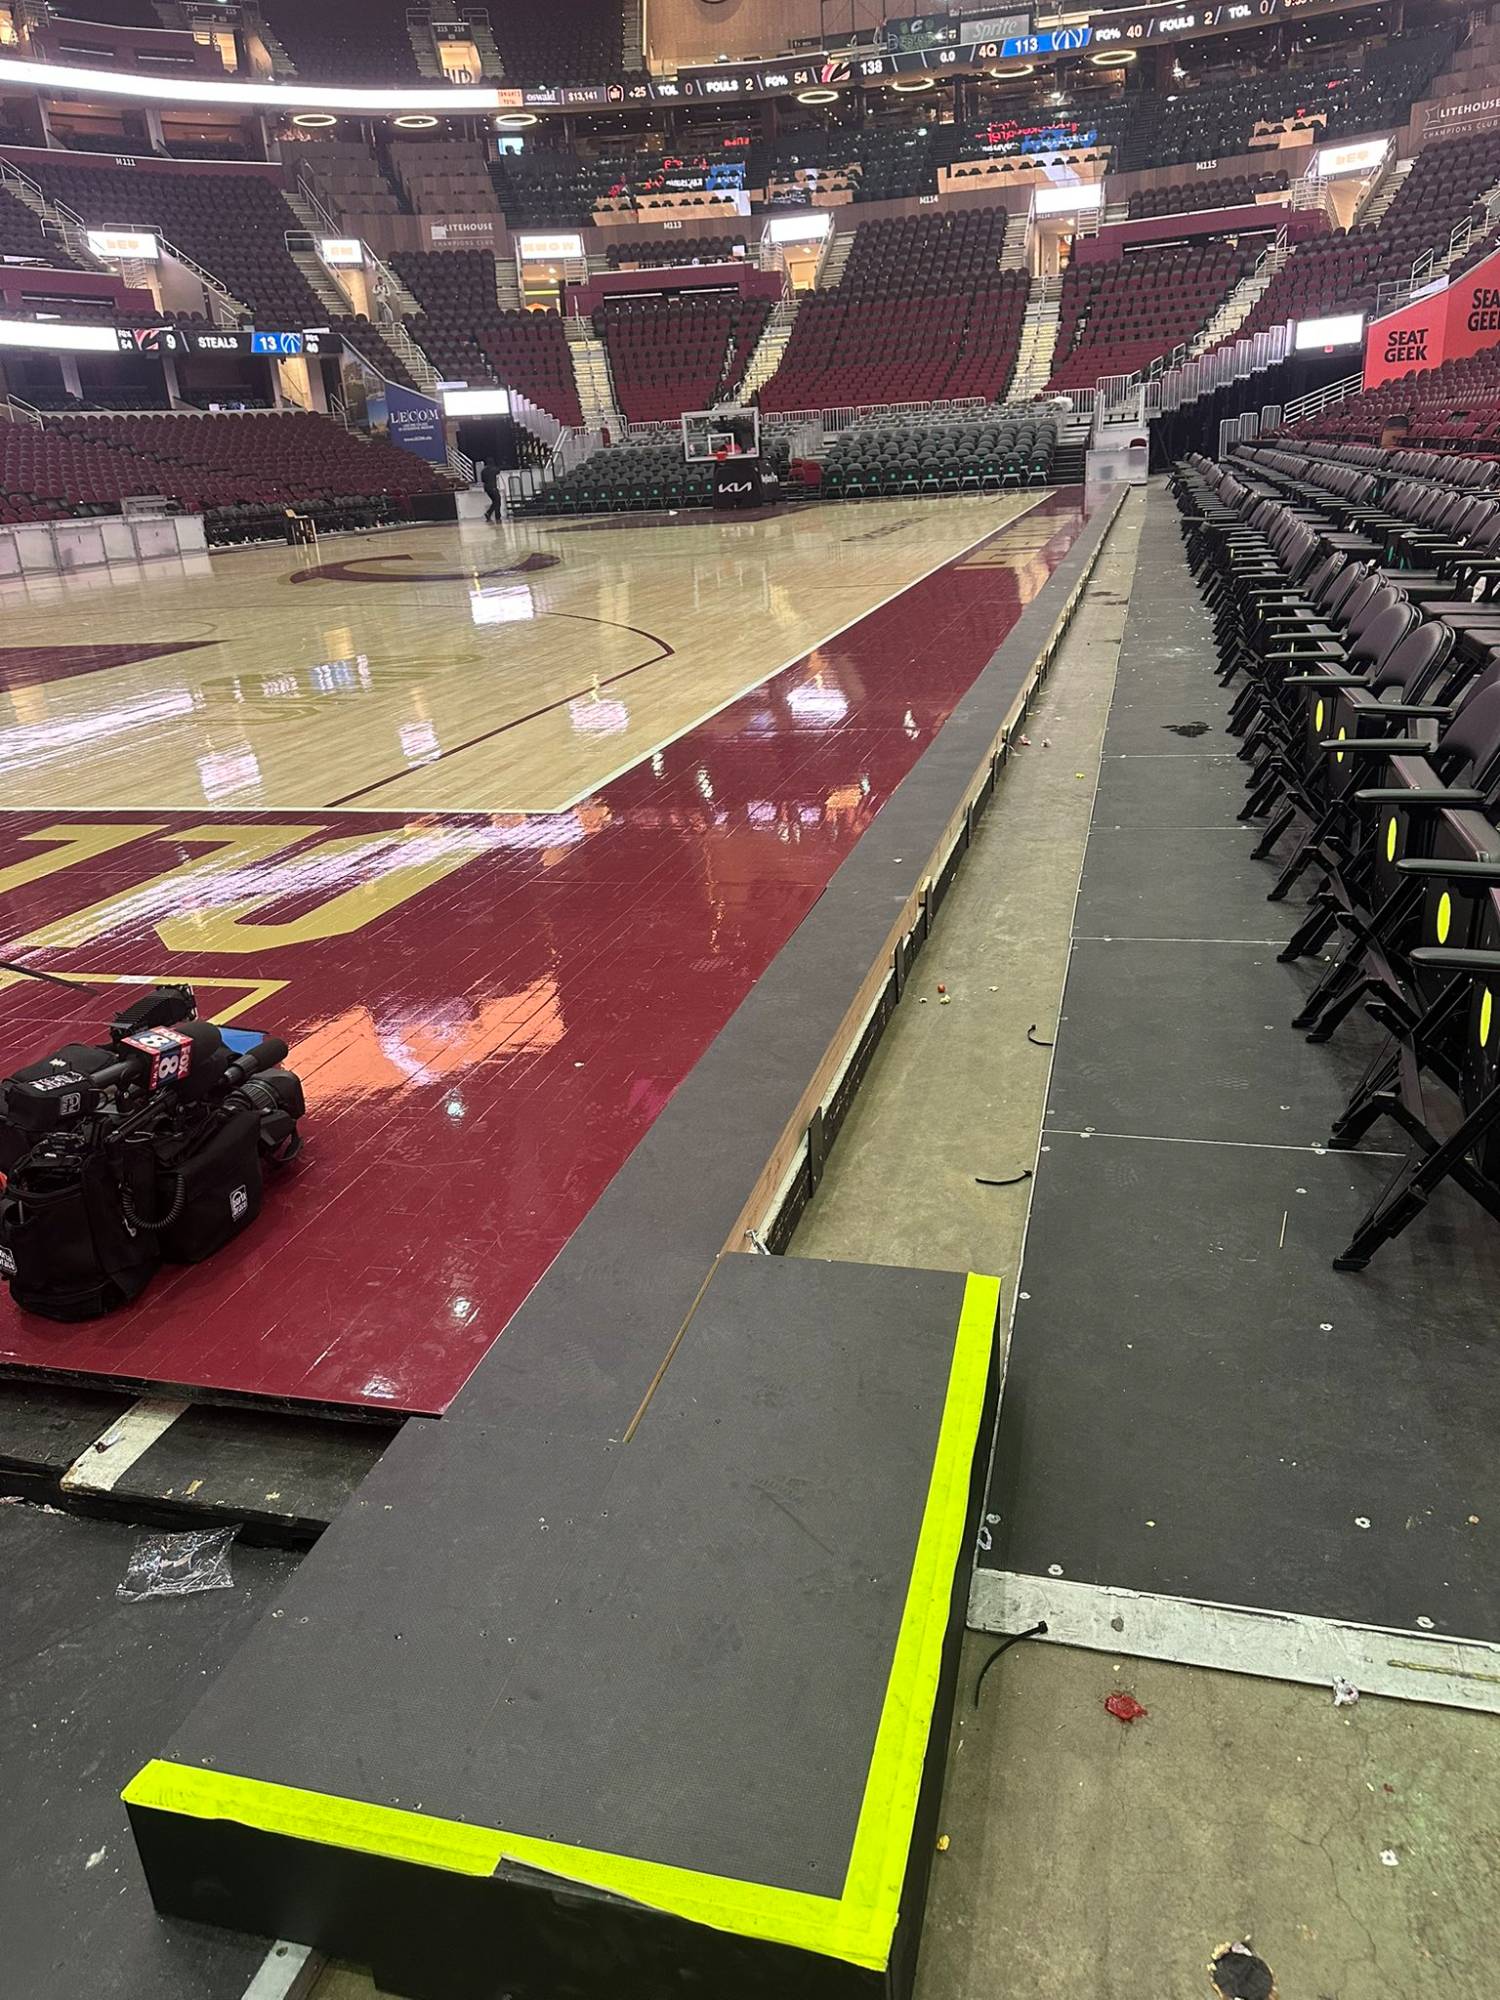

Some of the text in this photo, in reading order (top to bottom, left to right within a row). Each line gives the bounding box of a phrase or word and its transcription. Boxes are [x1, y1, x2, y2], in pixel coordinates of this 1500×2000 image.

[1228, 5, 1252, 19] TOL
[1260, 0, 1269, 14] 0
[973, 18, 1016, 40] Sprite
[1160, 12, 1213, 32] FOULS 2
[1096, 25, 1143, 42] FG% 40
[978, 44, 998, 58] 4Q
[1015, 38, 1039, 53] 113
[860, 61, 883, 75] 138
[706, 79, 753, 93] FOULS 2
[765, 71, 808, 88] FG% 54
[526, 90, 556, 101] oswald
[568, 91, 598, 102] $13,141
[629, 86, 646, 98] +25
[657, 82, 693, 96] TOL 0
[1440, 98, 1500, 118] LITEHOUSE
[1423, 119, 1498, 139] CHAMPIONS CLUB
[1196, 160, 1217, 171] M115
[1472, 287, 1500, 310] SEA
[1467, 310, 1500, 332] GEE
[166, 334, 177, 350] 9
[198, 336, 238, 349] STEALS
[260, 336, 277, 350] 13
[1388, 328, 1429, 346] SEAT
[1384, 345, 1428, 363] GEEK
[390, 408, 439, 424] LECOM
[718, 481, 752, 493] KIA
[158, 1055, 179, 1079] 8
[179, 1045, 191, 1073] FOX
